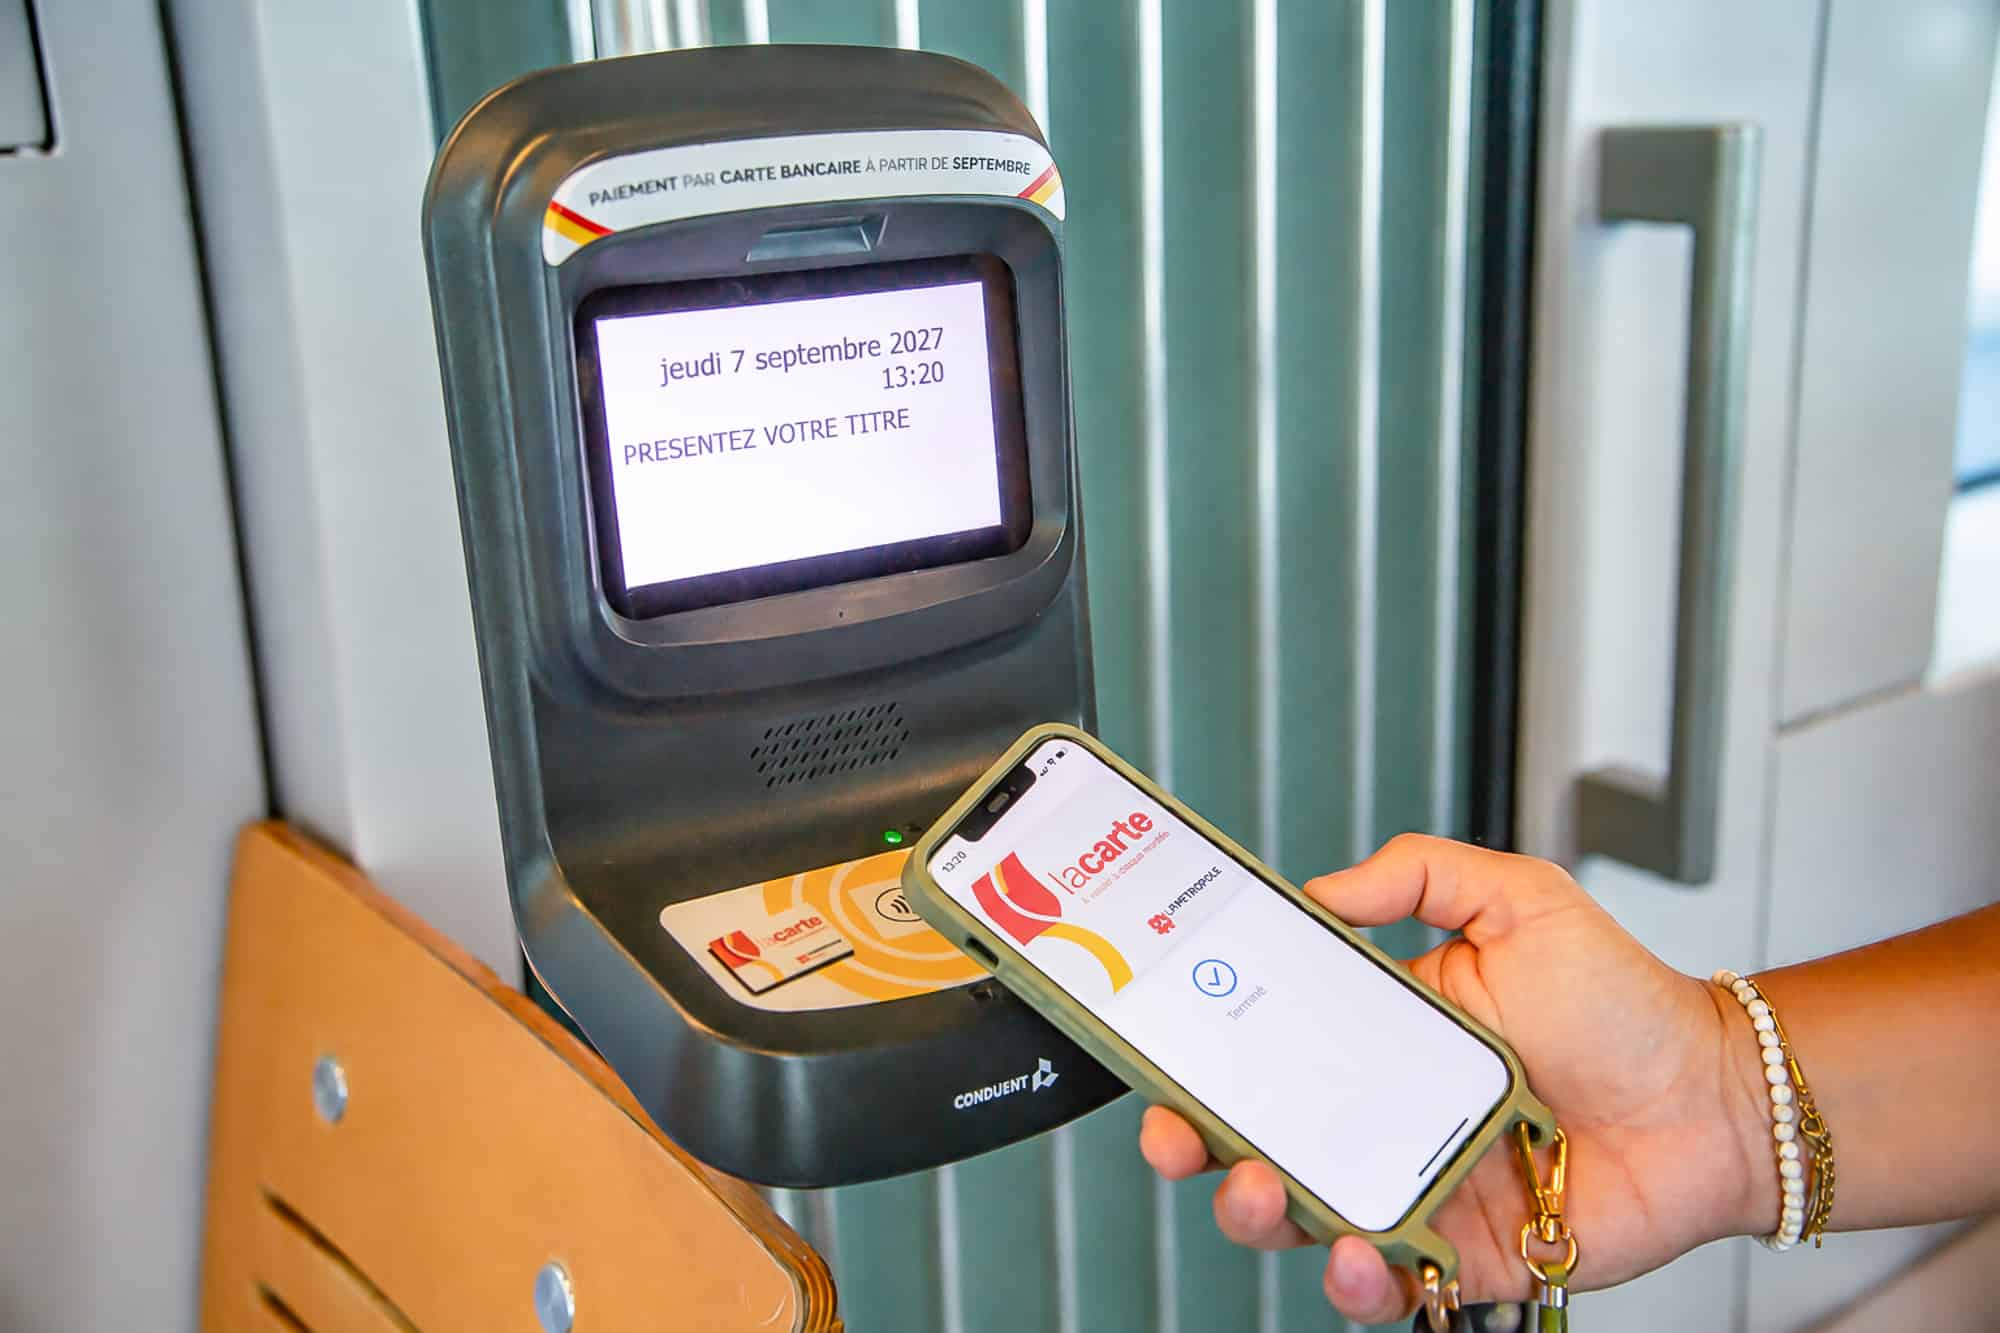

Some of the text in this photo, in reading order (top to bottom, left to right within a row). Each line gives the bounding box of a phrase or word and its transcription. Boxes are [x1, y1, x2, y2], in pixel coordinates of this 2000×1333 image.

[588, 154, 1031, 207] PAIEMENT PAR CARTE BANCAIRE À PARTIR DE SEPTEMBRE
[660, 327, 944, 388] jeudi 7 septembre 2027
[882, 360, 945, 389] 13:20
[623, 407, 911, 466] PRESENTEZ VOTRE TITRE
[953, 1074, 1029, 1109] CONDUENT
